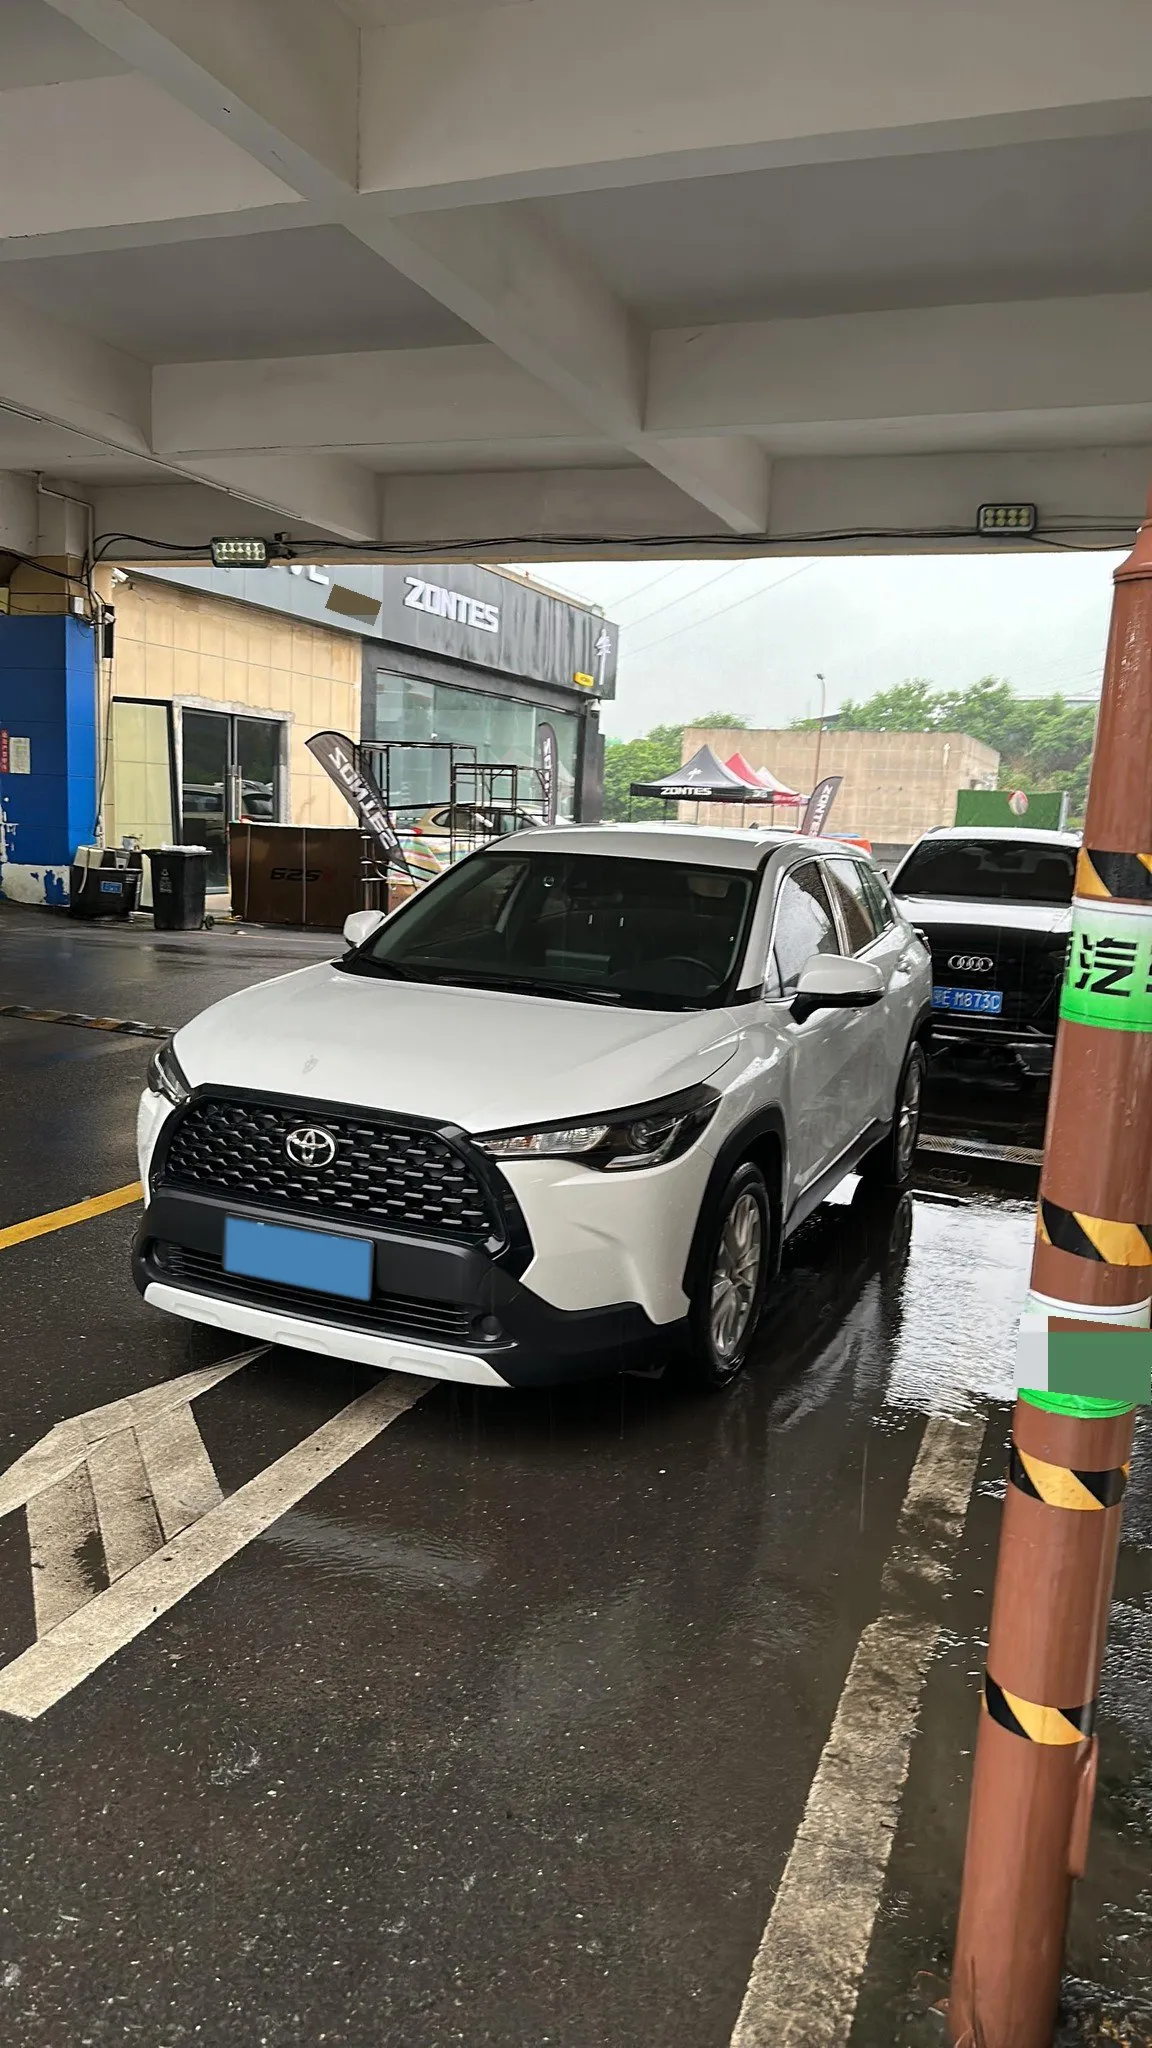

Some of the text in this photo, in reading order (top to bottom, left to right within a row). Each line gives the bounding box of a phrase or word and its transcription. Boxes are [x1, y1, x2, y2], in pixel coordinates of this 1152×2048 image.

[404, 576, 499, 633] ZONTES
[328, 746, 398, 850] ZONTES
[660, 787, 712, 796] ZONTES
[1075, 934, 1152, 997] 汽
